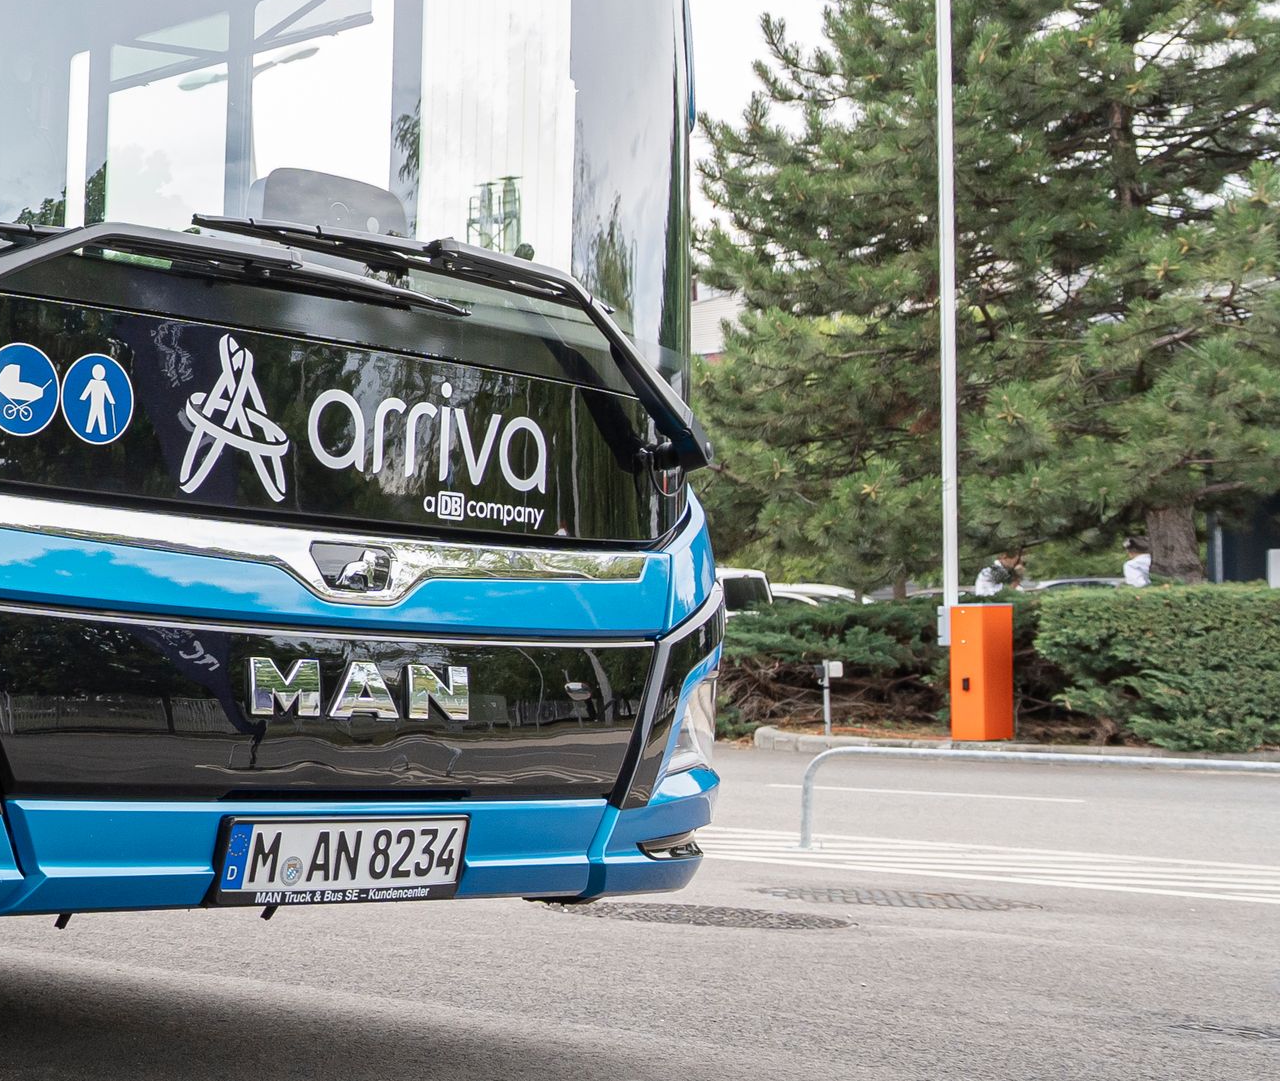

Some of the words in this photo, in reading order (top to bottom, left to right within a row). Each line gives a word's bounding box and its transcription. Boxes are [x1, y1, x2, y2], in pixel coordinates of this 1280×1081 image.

[308, 382, 547, 494] arriva
[423, 496, 436, 514] a
[439, 493, 462, 519] DB
[467, 499, 545, 530] company
[248, 656, 471, 721] MAN
[226, 865, 238, 881] D
[248, 831, 283, 883] M
[306, 830, 363, 882] AN
[368, 827, 459, 880] 8234
[255, 891, 282, 904] MAN
[284, 891, 312, 903] Truck
[313, 890, 322, 902] &
[323, 889, 343, 902] Bus
[345, 889, 359, 901] SE
[368, 886, 430, 900] Kundencenter
